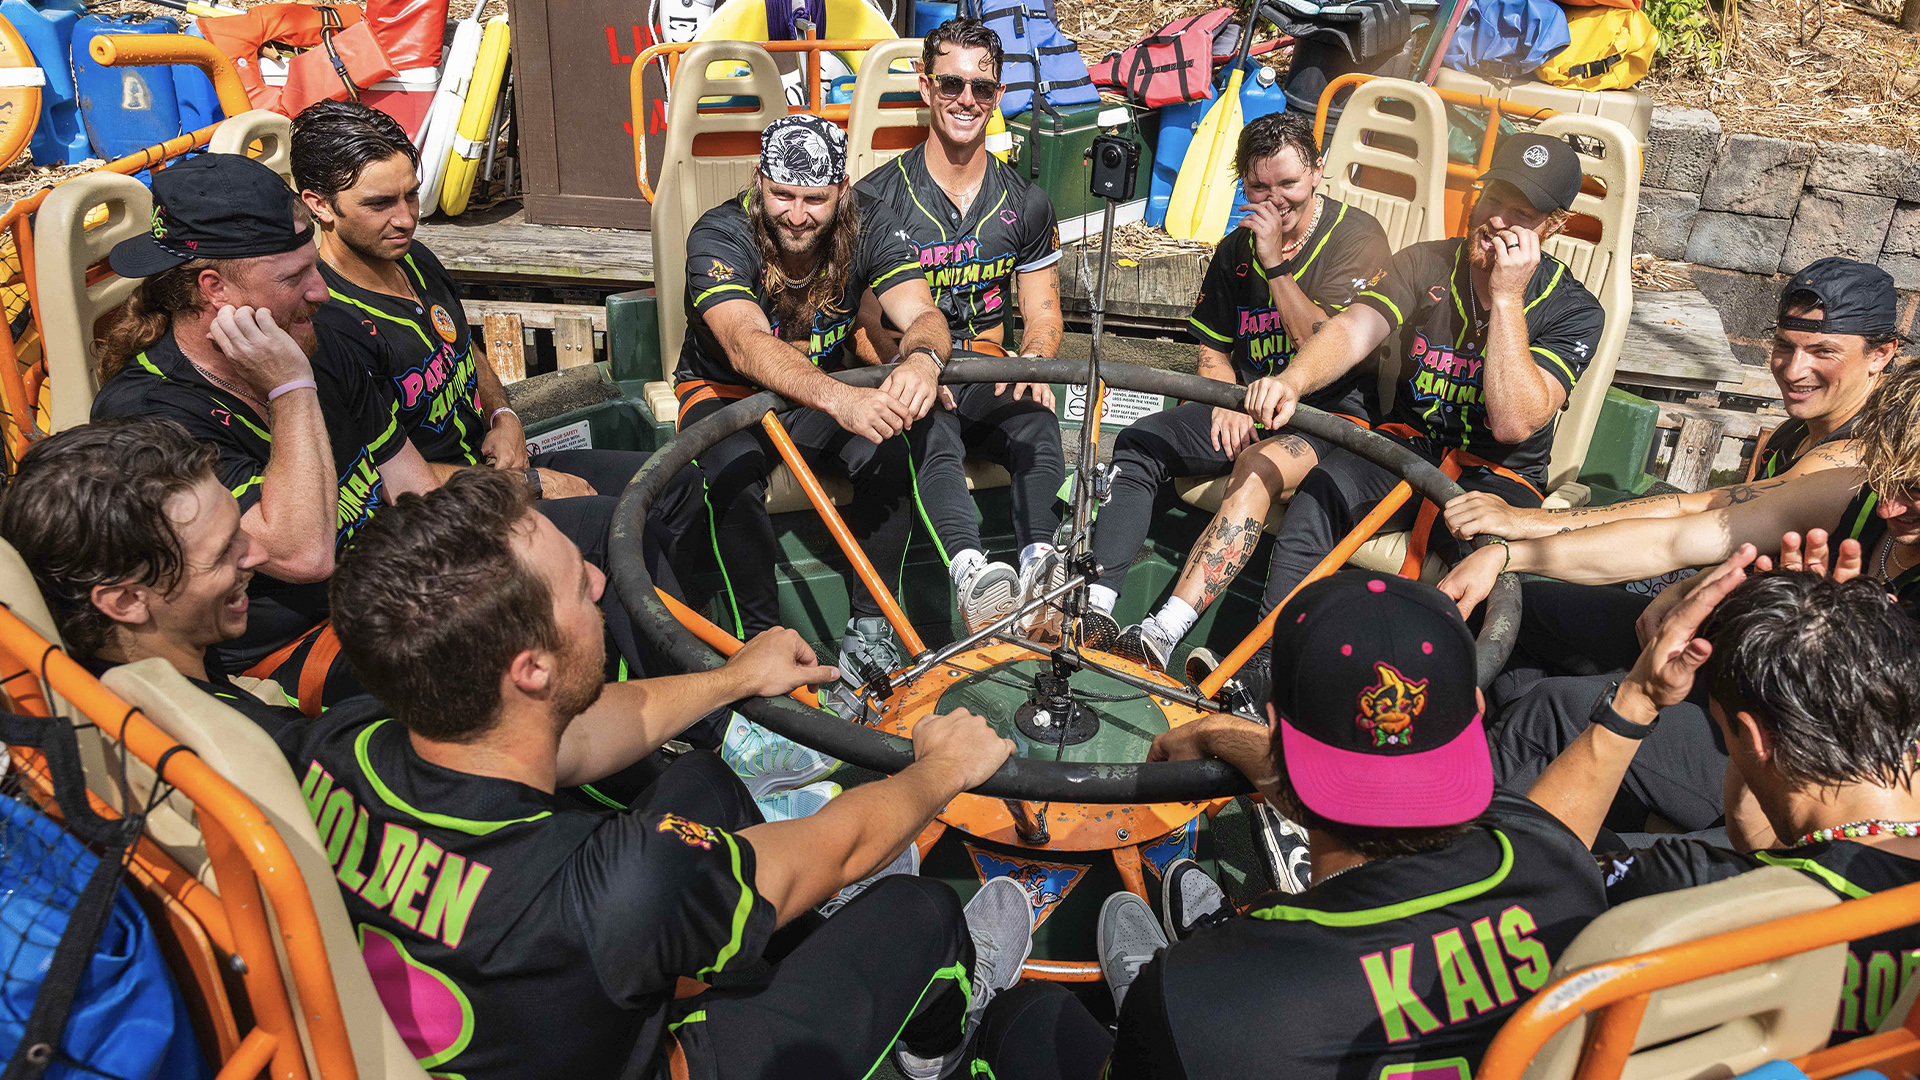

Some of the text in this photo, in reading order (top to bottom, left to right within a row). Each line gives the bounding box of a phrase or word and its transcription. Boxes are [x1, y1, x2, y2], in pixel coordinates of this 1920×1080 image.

[915, 240, 978, 269] ARTY
[983, 285, 1003, 313] 5
[1240, 311, 1281, 336] PART
[1410, 335, 1482, 378] PARTY
[300, 759, 492, 949] HOLDEN
[1359, 904, 1551, 1044] KAIS
